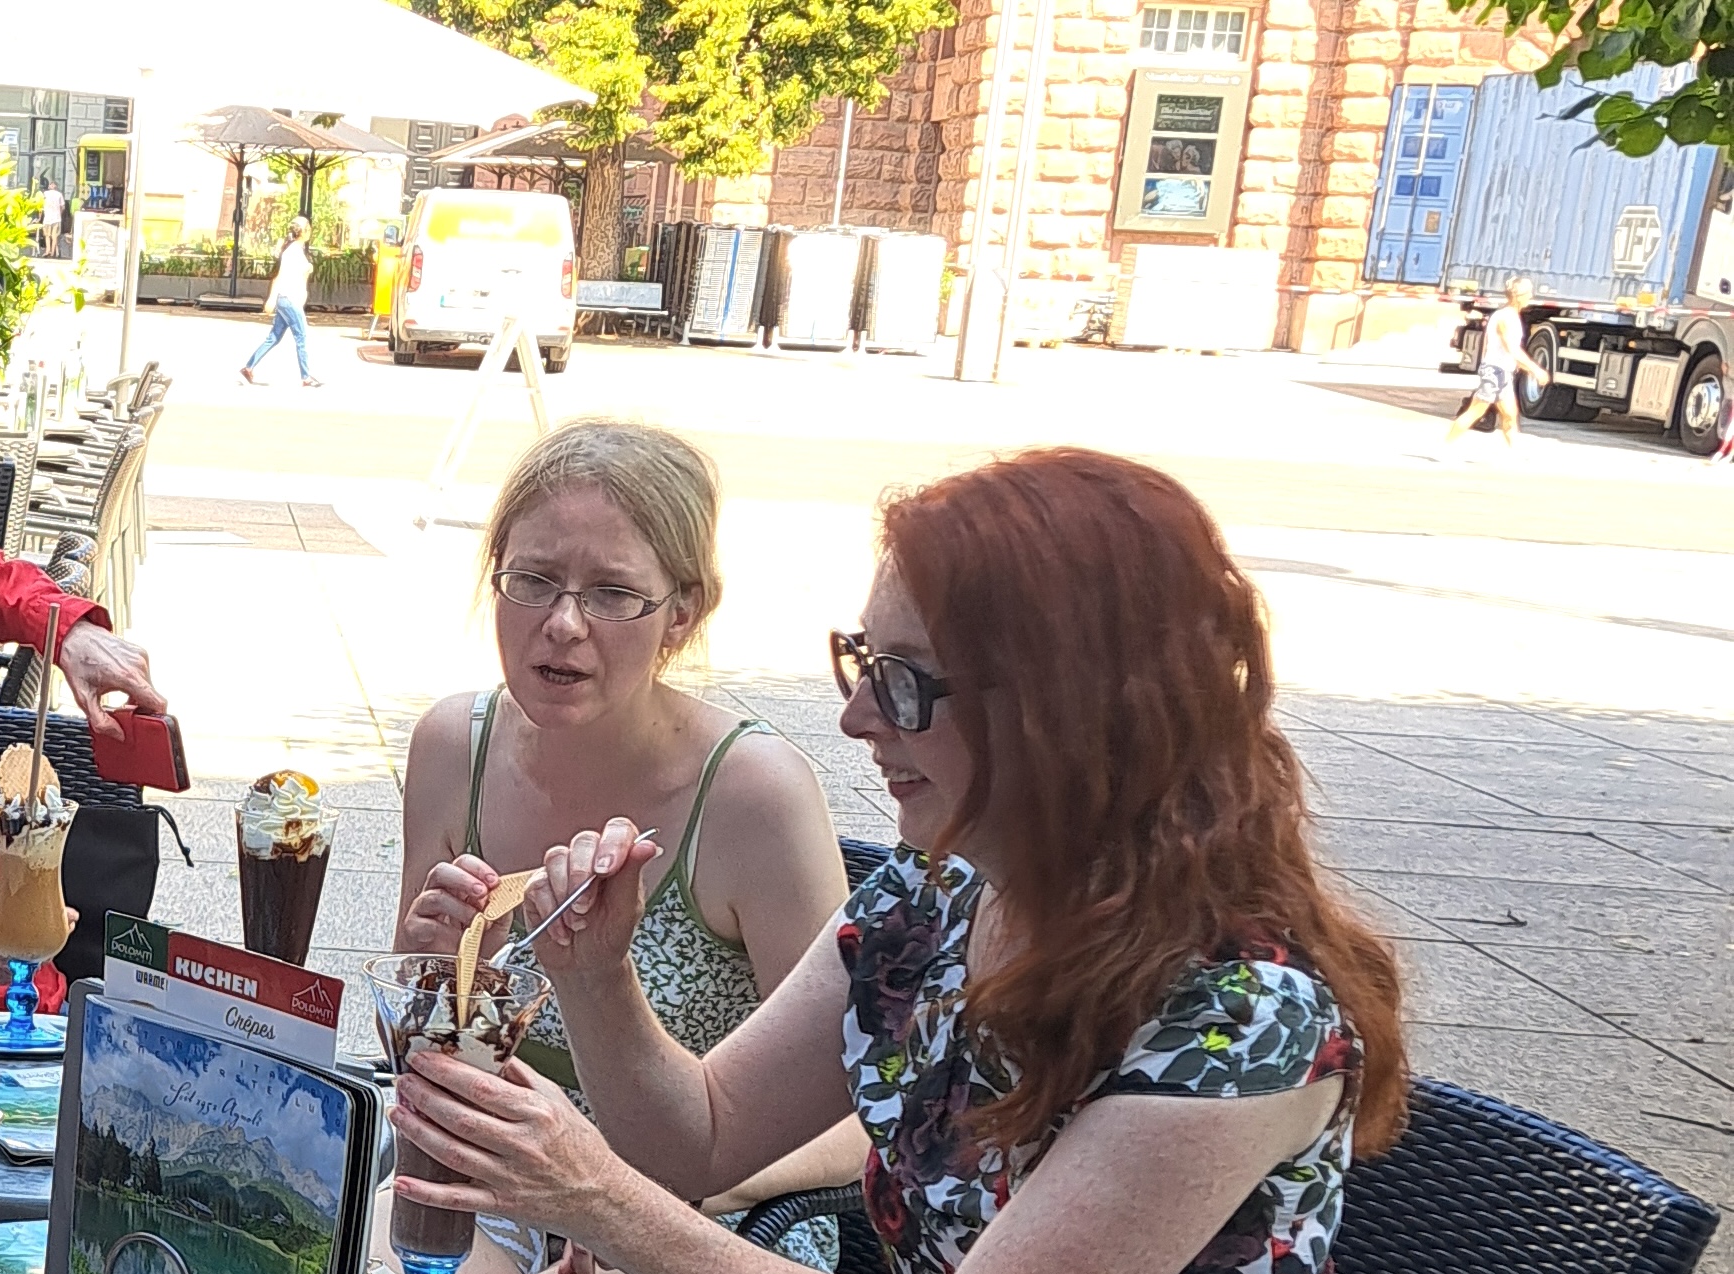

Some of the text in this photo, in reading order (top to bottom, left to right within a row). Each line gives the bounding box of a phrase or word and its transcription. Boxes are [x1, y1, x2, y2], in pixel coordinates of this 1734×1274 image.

[111, 940, 154, 966] DOLOMITI
[175, 956, 259, 1000] KUCHEN
[224, 1005, 277, 1041] Crêpes
[291, 996, 335, 1021] DOLOMITI
